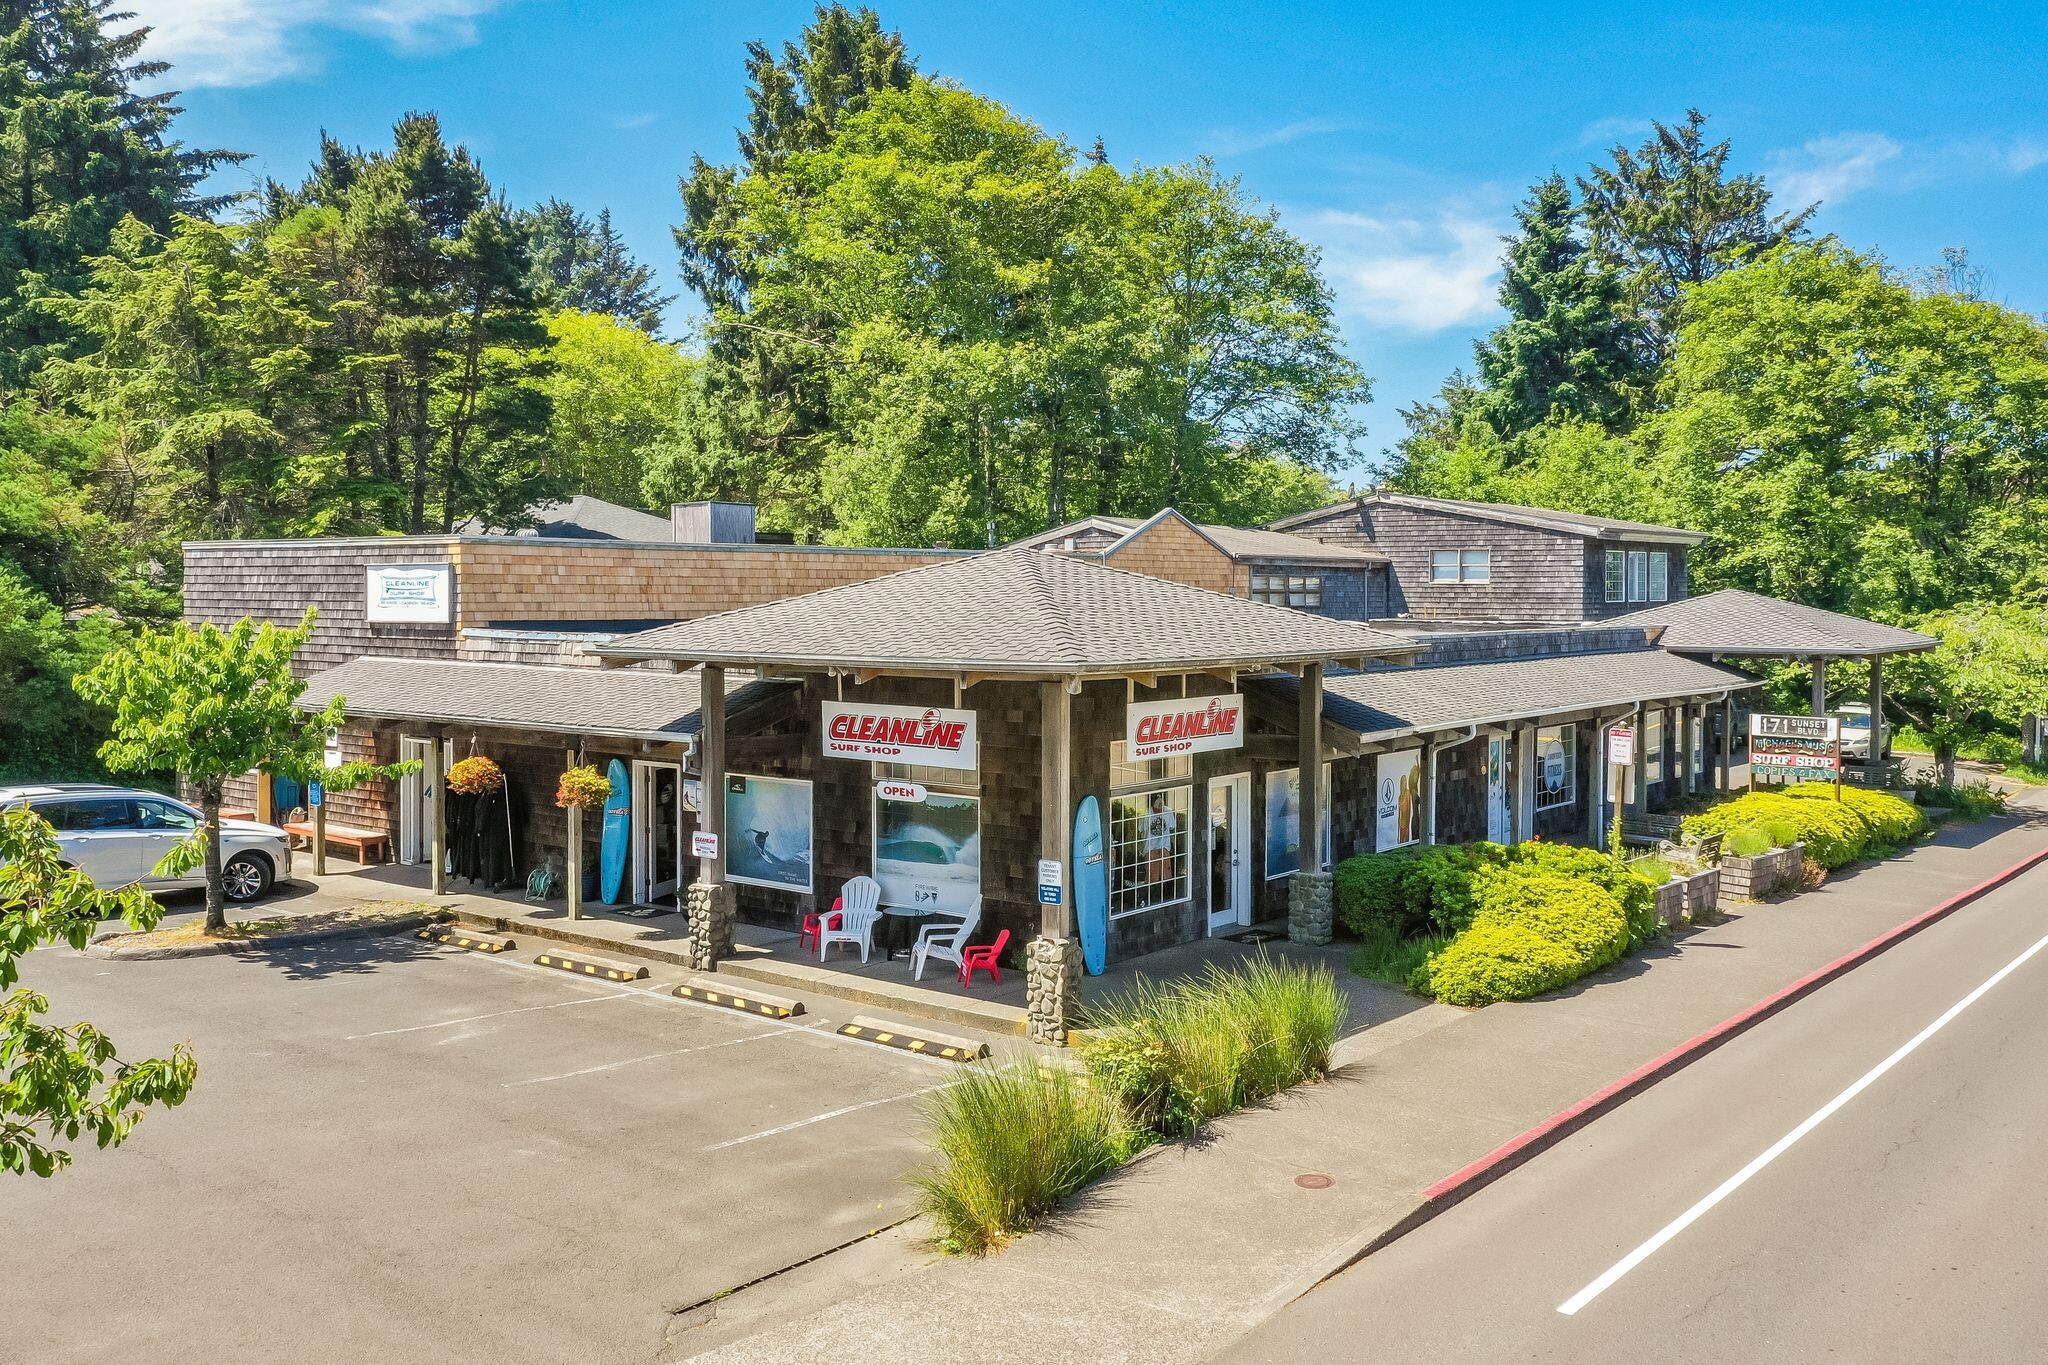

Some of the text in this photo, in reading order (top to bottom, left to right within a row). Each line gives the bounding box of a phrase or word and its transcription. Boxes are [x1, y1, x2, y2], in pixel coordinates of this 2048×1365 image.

[829, 708, 967, 751] CLEANLINE
[1135, 700, 1239, 745] CLEANLINE
[1762, 718, 1826, 734] 171 SUNSET
[1797, 728, 1820, 736] BLVD.
[830, 743, 901, 756] SURF SHOP
[1135, 742, 1193, 756] SURF SHOP
[1752, 753, 1834, 768] SURF SHOP
[1757, 766, 1796, 776] COPIES
[1808, 769, 1831, 778] FAX
[883, 786, 915, 798] OPEN
